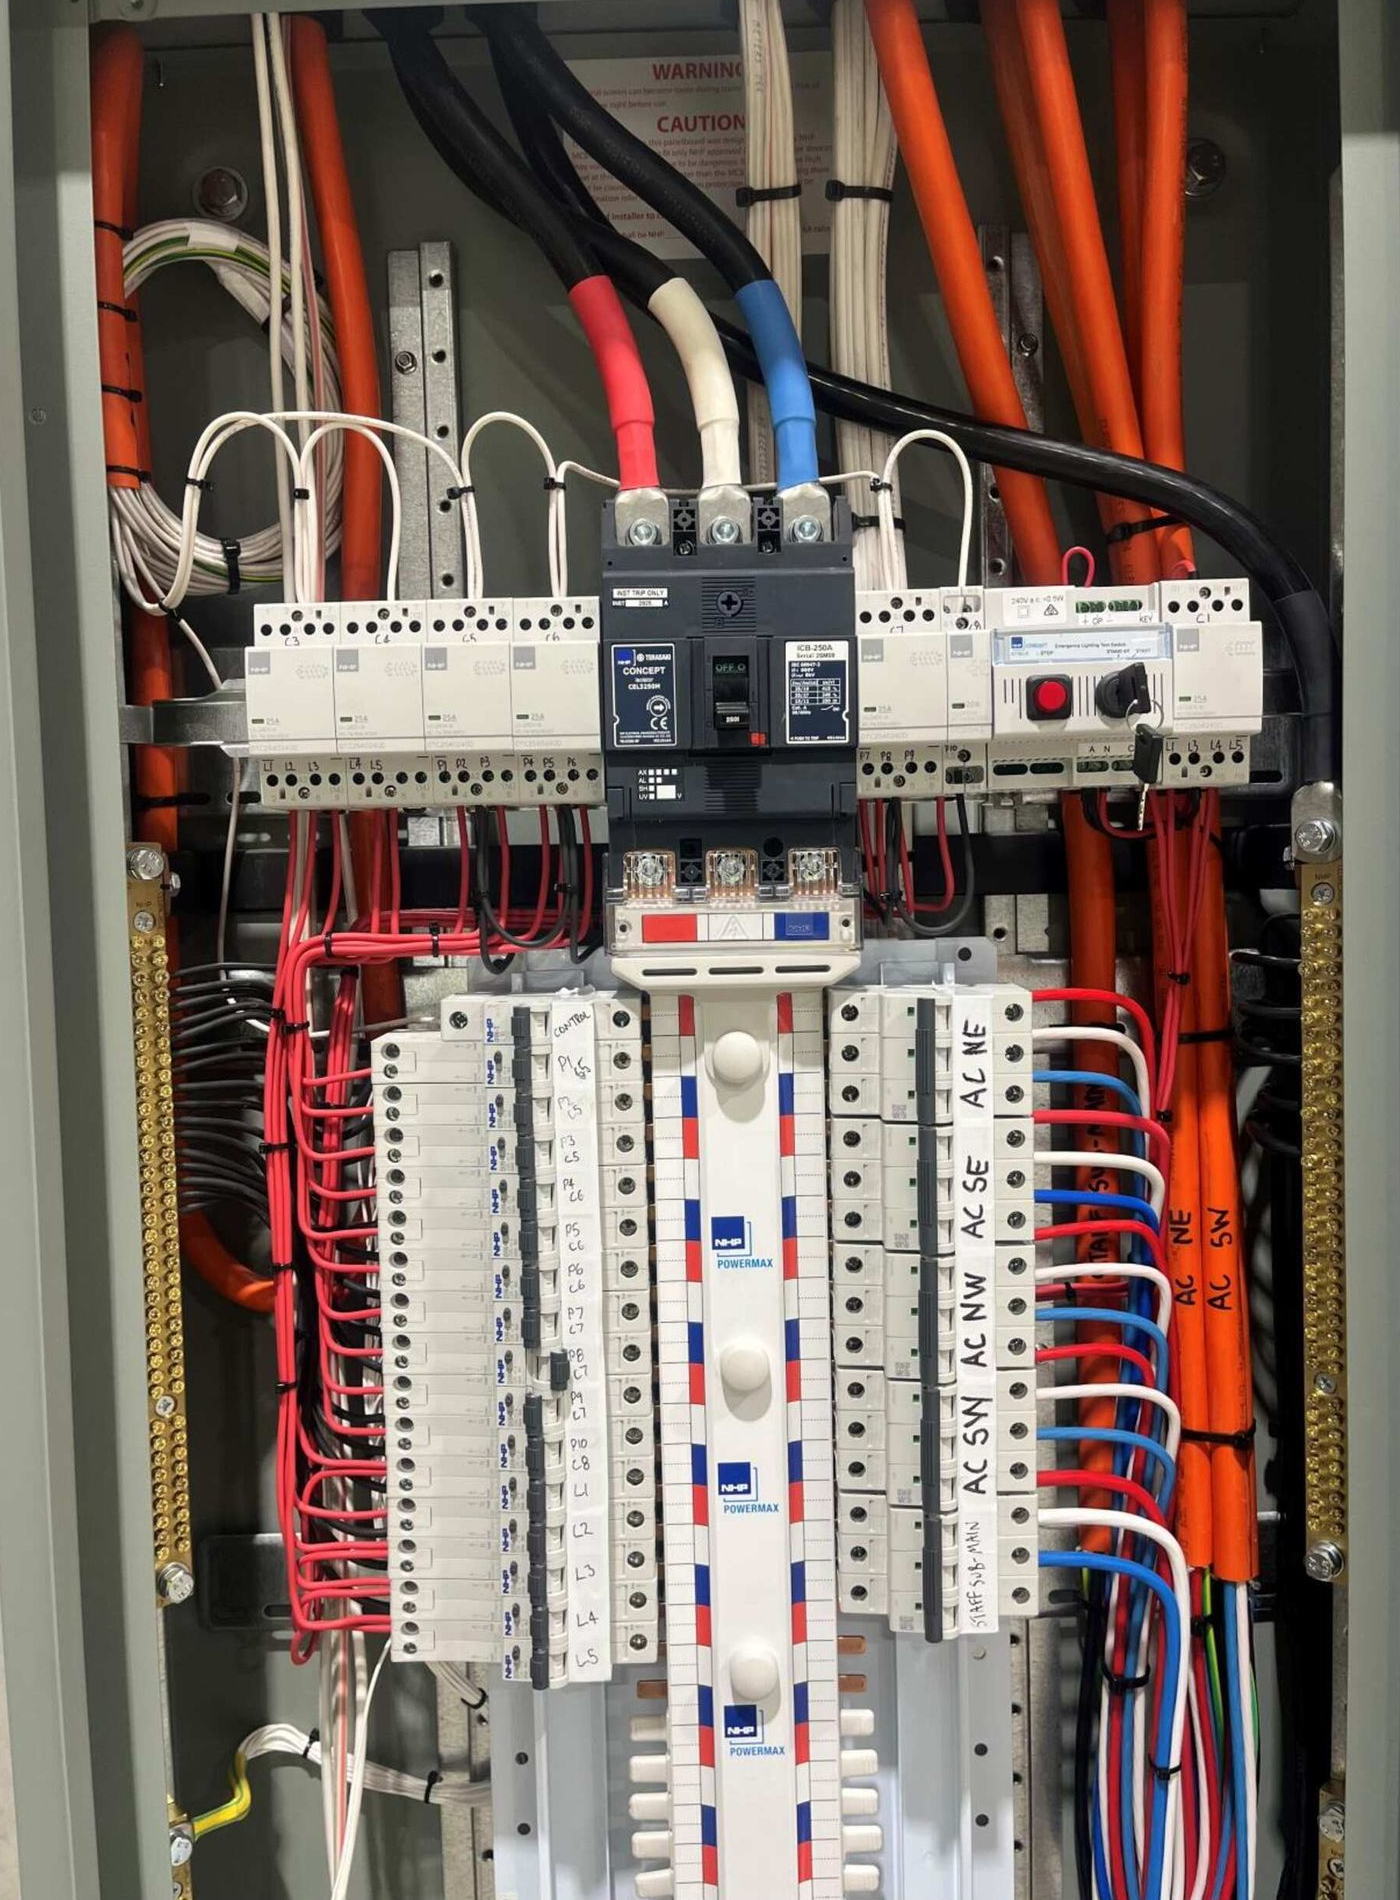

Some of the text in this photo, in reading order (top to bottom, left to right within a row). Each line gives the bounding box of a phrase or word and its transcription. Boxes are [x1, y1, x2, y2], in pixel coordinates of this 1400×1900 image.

[657, 114, 745, 132] CAUTION
[1196, 613, 1210, 623] C1
[623, 666, 666, 675] CONCEPT
[554, 1010, 591, 1038] CONTROL
[962, 1019, 987, 1055] NE
[961, 1155, 989, 1238] AC SE
[565, 1222, 580, 1237] P5
[714, 1238, 742, 1247] NHP
[717, 1258, 774, 1270] POWERMAX
[1170, 1209, 1197, 1306] AC NE
[1207, 1207, 1233, 1310] AC SW
[568, 1263, 584, 1277] P6
[568, 1307, 584, 1320] P7
[960, 1272, 987, 1367] AC NW
[570, 1391, 583, 1405] P9
[571, 1439, 588, 1450] P10
[963, 1459, 988, 1494] AC
[721, 1483, 749, 1493] NHP
[723, 1503, 779, 1514] POWERMAX
[573, 1522, 594, 1538] L2
[575, 1564, 596, 1581] L3
[966, 1591, 988, 1627] STAFF
[577, 1611, 599, 1627] L4
[576, 1649, 598, 1667] L5
[727, 1726, 754, 1735] NHP
[730, 1746, 785, 1757] POWERMAX
